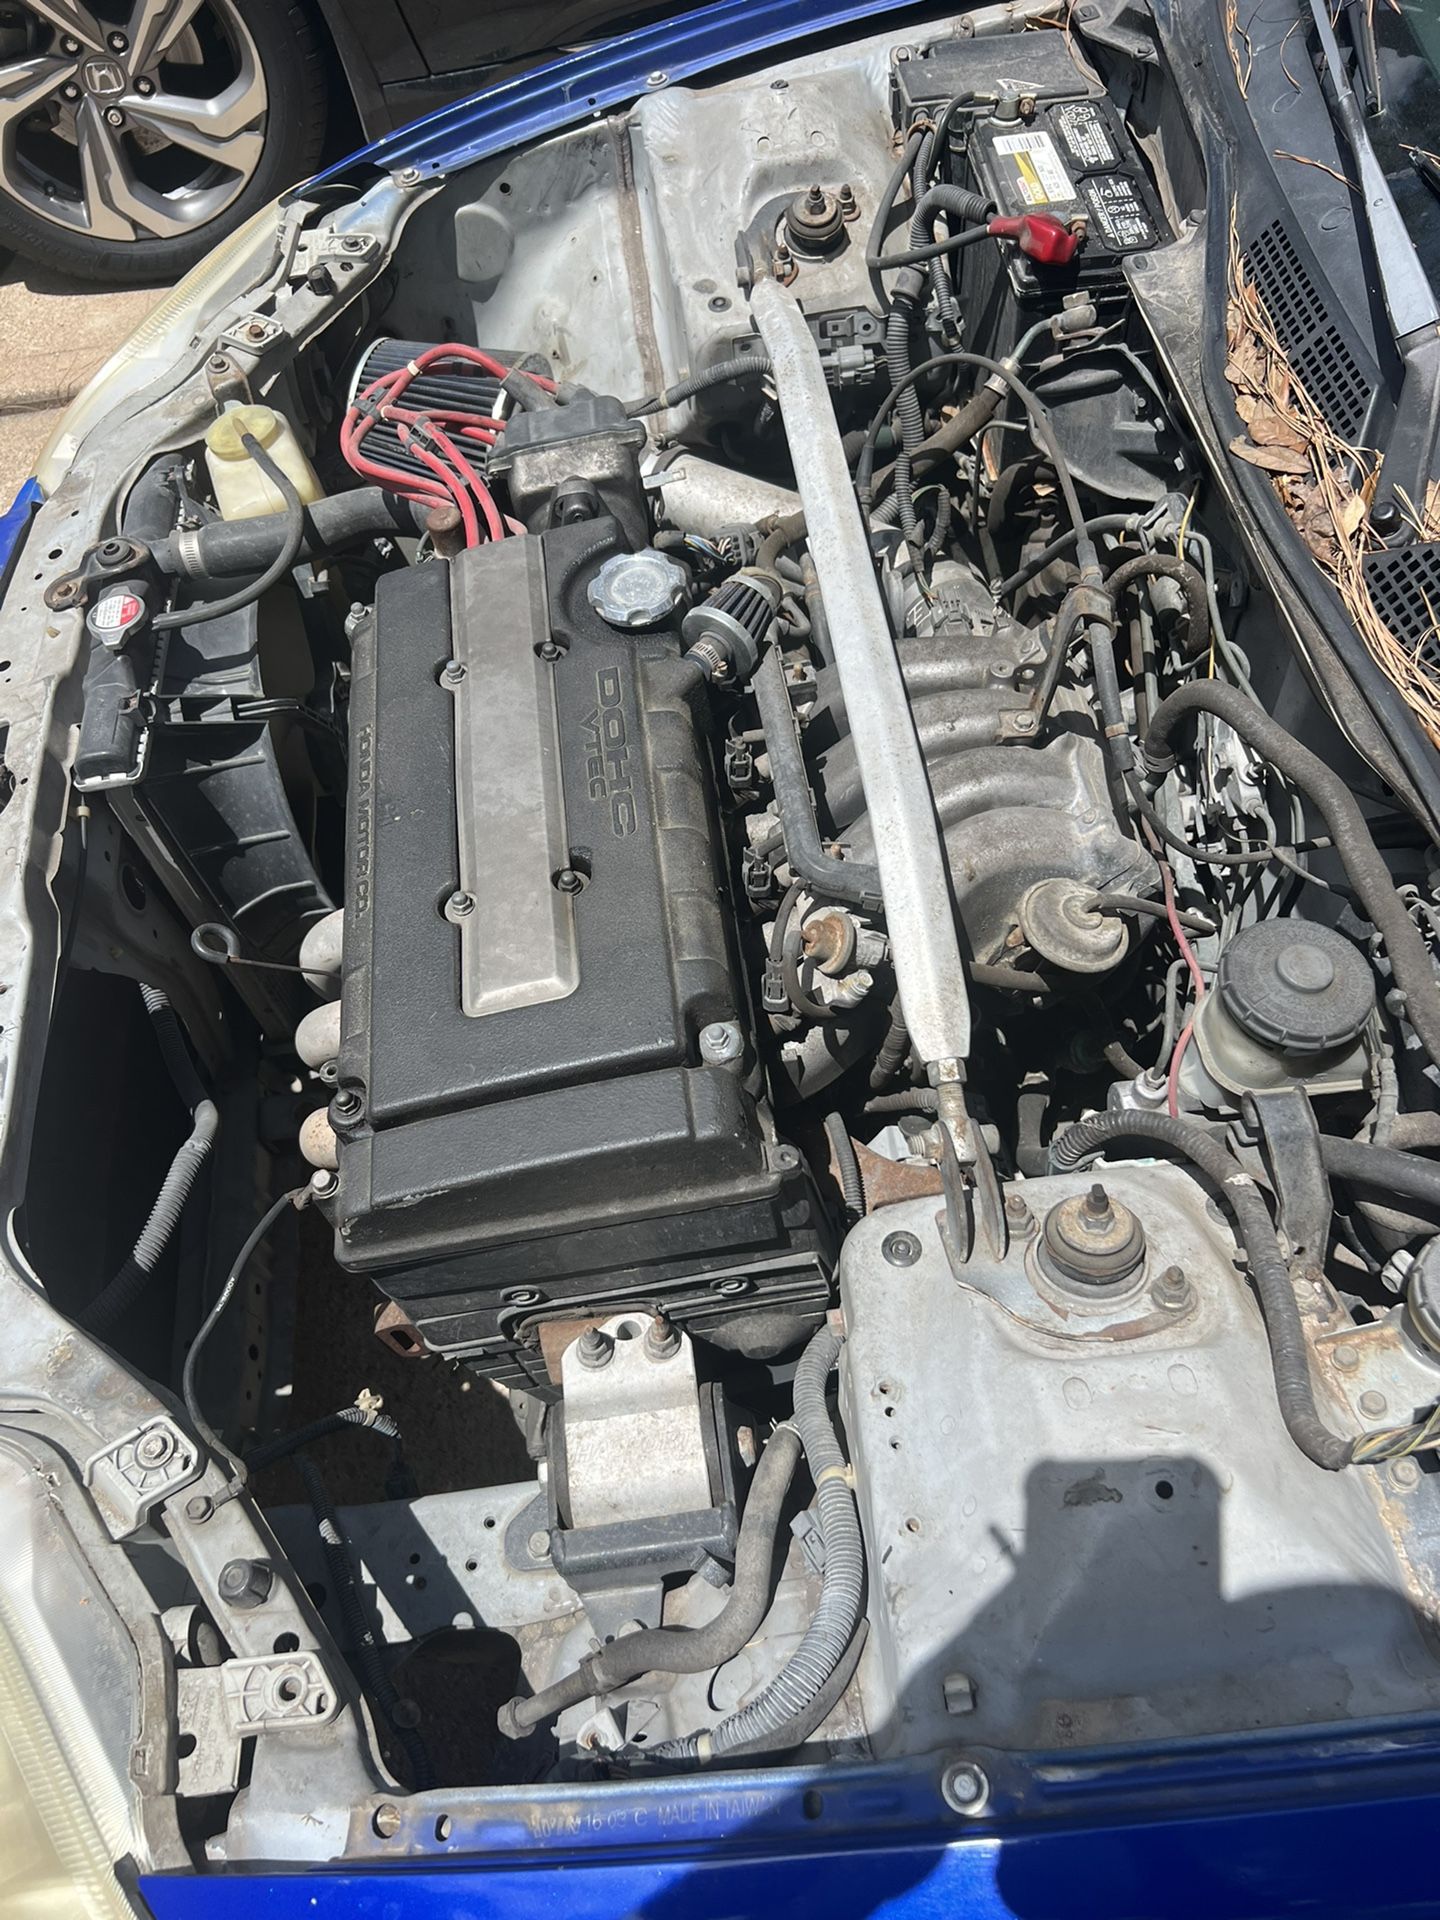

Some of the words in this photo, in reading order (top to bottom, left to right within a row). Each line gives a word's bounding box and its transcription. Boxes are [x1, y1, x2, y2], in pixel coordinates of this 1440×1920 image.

[1087, 188, 1102, 208] POISON
[1097, 211, 1113, 234] DANGER
[355, 723, 374, 797] HONDA
[580, 708, 608, 802] VTEC
[596, 666, 638, 838] DOHC
[355, 798, 373, 879] MOTOR
[353, 879, 373, 919] CO.
[657, 1802, 700, 1825] MADE
[705, 1799, 720, 1821] IN
